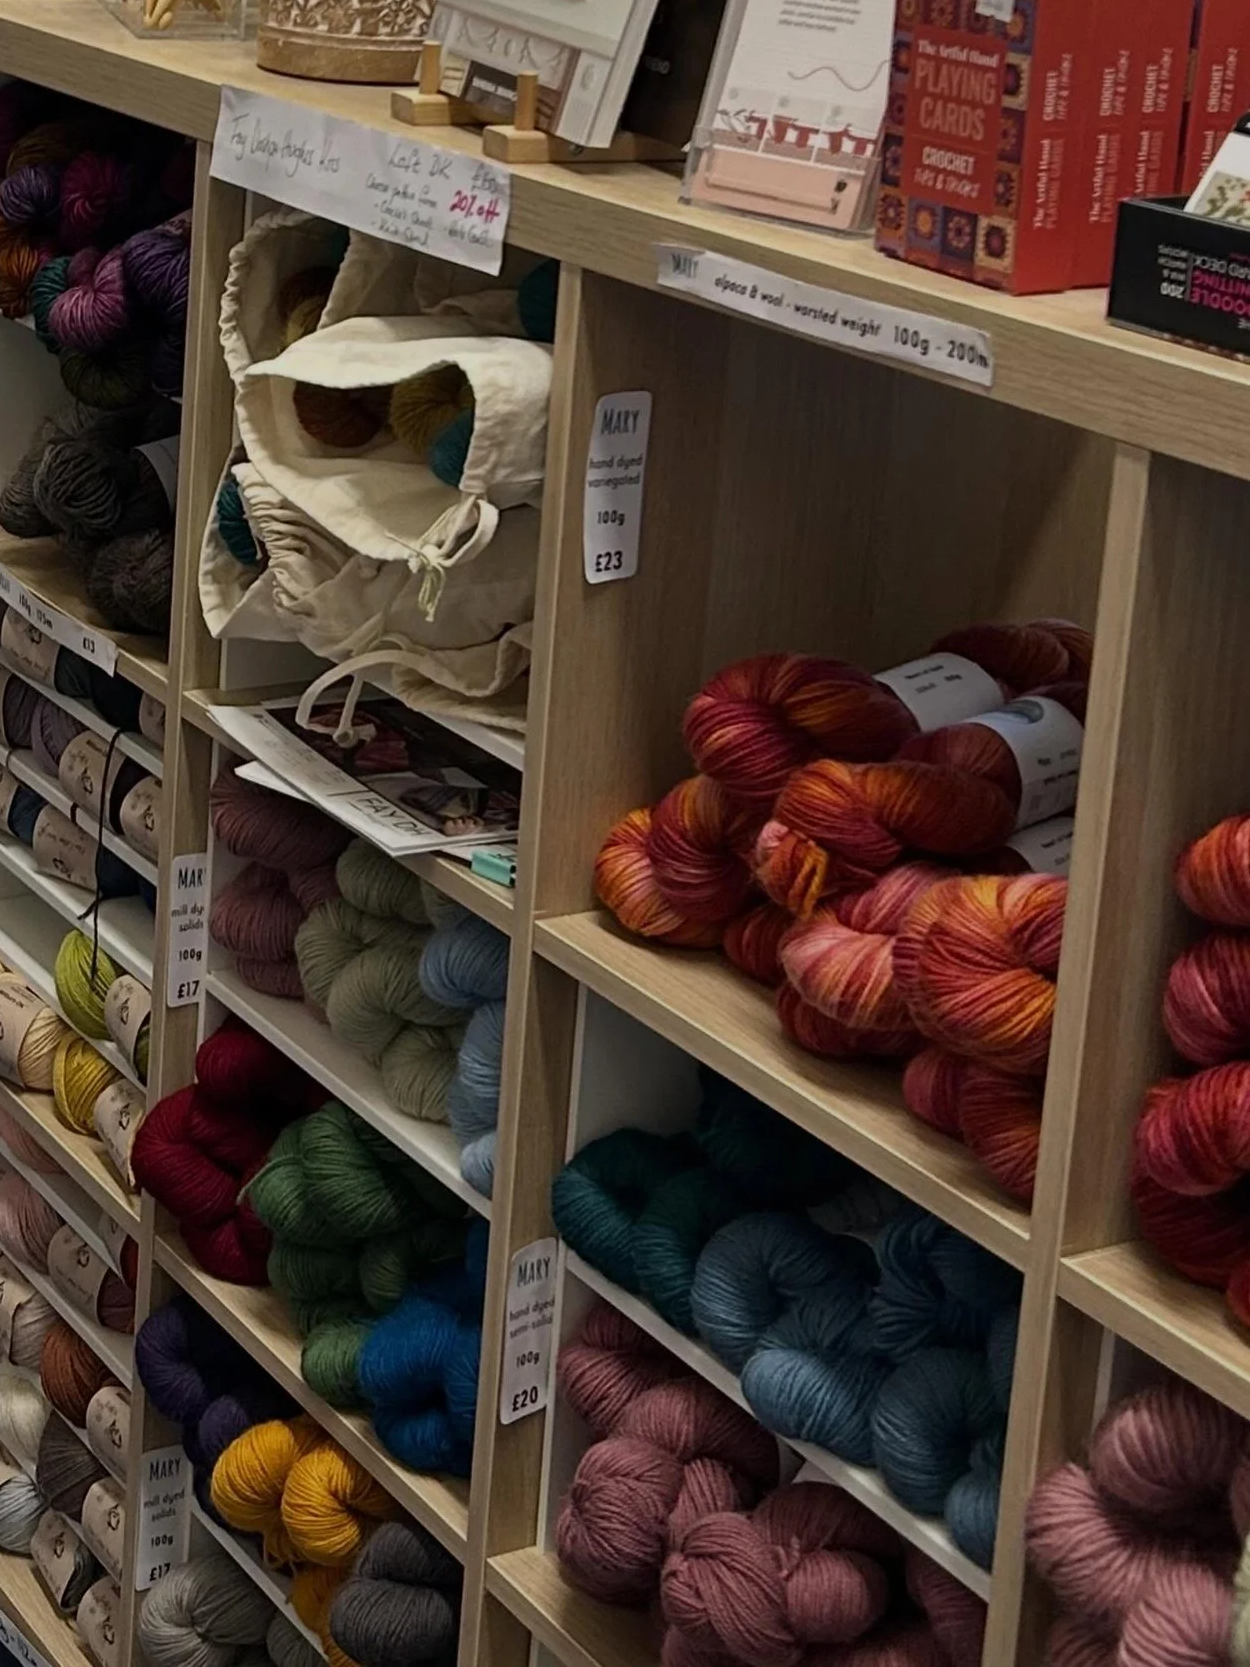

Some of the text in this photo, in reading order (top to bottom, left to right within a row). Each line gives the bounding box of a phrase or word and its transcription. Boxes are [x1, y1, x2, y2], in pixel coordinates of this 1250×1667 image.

[918, 39, 999, 68] The Artful Hand
[915, 58, 997, 105] PLAYING
[1099, 67, 1117, 117] CROCHET
[1141, 64, 1159, 114] CROCHET
[1206, 63, 1225, 114] CROCHET
[1042, 70, 1058, 121] CROCHET
[919, 97, 986, 141] CARDS
[922, 146, 976, 175] CROCHET
[449, 189, 476, 218] 20%
[714, 274, 748, 297] alpaca
[760, 285, 784, 308] wool
[793, 300, 838, 326] worsted
[840, 314, 882, 338] weight
[893, 325, 930, 356] 100g
[946, 339, 991, 369] 200m
[601, 408, 641, 435] MARY
[589, 453, 643, 471] hand dyed
[587, 472, 641, 490] variegated
[597, 509, 626, 526] 100g
[595, 550, 623, 573] £23
[177, 866, 207, 890] MAR
[171, 905, 189, 919] mill
[178, 947, 203, 963] 100g
[177, 979, 201, 1000] £17
[516, 1256, 552, 1288] MARY
[509, 1305, 531, 1323] hand
[515, 1350, 541, 1369] 100g
[511, 1384, 540, 1413] £20
[148, 1456, 182, 1484] MARY
[161, 1488, 186, 1507] dyed
[150, 1534, 175, 1550] 100g
[148, 1562, 172, 1583] £17
